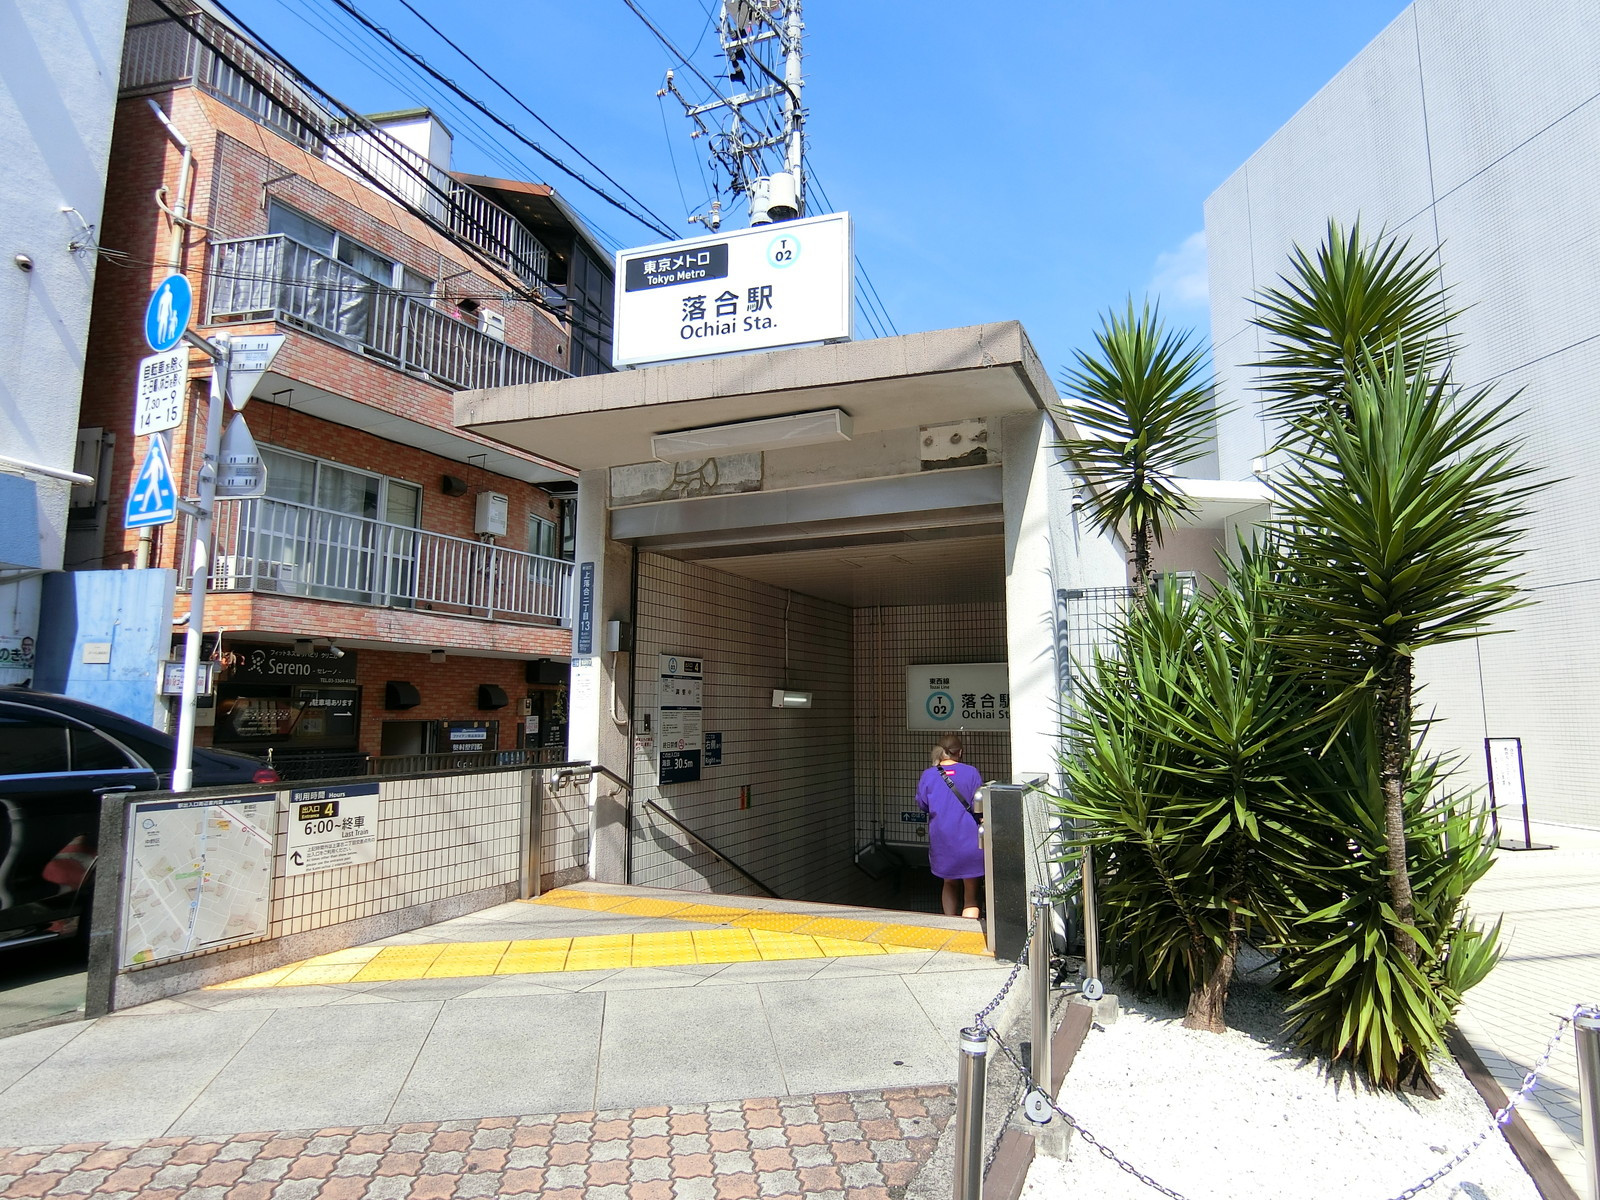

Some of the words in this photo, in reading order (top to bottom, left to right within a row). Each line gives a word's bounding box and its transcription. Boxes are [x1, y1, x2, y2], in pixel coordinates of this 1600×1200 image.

[780, 240, 787, 248] T
[775, 250, 792, 262] 02
[643, 252, 710, 274] 東京メトロ
[647, 274, 675, 286] Tokyo
[677, 269, 706, 282] Metro
[682, 284, 774, 322] 落合駅
[680, 318, 736, 340] Ochiai
[743, 316, 778, 332] Sta.
[166, 406, 178, 422] 15
[581, 622, 590, 631] 13
[268, 658, 311, 676] Sereno
[937, 696, 943, 705] T
[933, 706, 947, 715] 02
[962, 709, 995, 719] Ochiai
[674, 758, 694, 769] 30.5m
[295, 791, 326, 801] 利用時間
[302, 805, 320, 814] 出入口
[324, 803, 334, 816] 4
